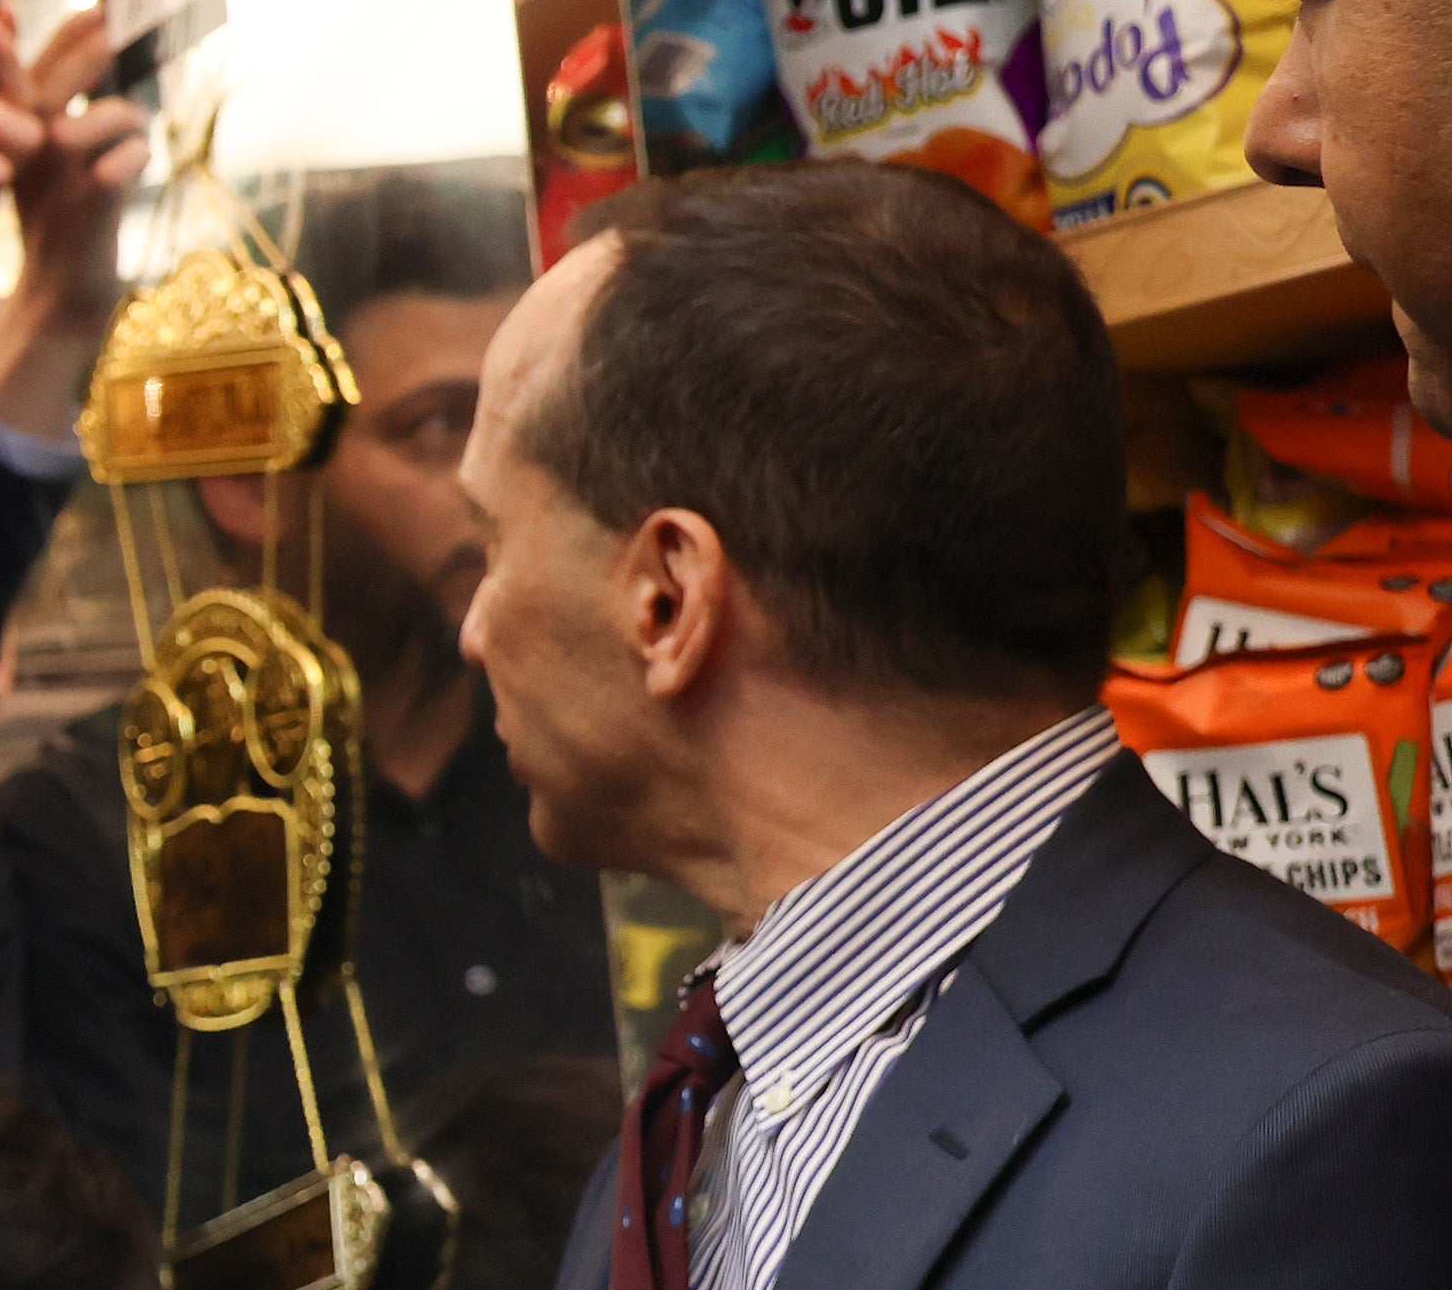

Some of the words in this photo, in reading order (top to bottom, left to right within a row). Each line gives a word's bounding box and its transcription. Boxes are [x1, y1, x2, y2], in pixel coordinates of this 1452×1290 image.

[1177, 759, 1350, 829] HAL'S
[1269, 831, 1351, 852] YORK
[1284, 857, 1383, 895] CHIPS
